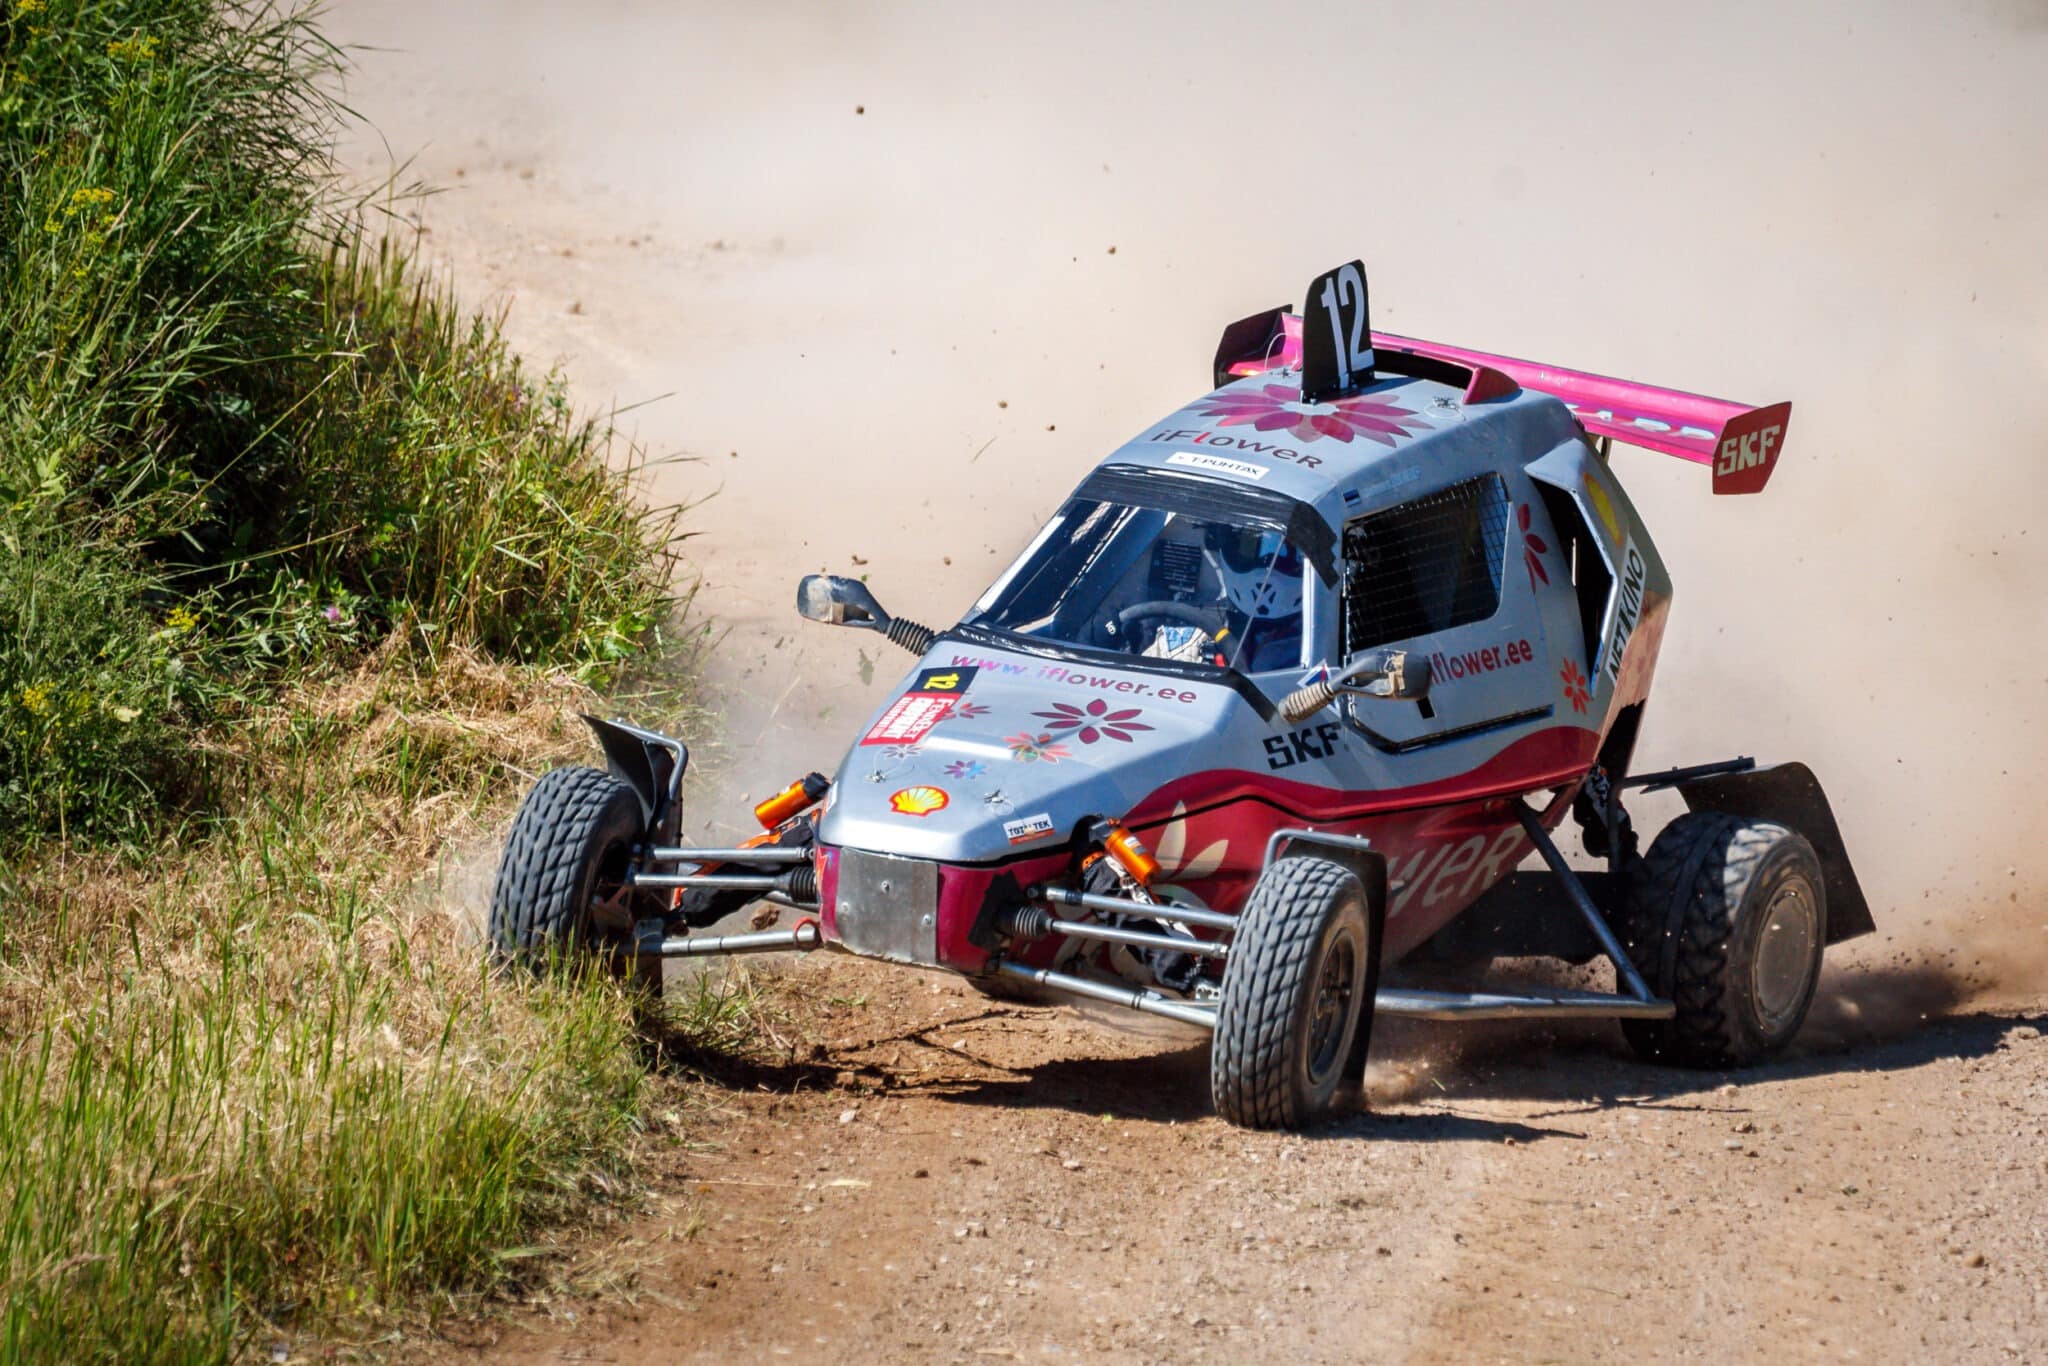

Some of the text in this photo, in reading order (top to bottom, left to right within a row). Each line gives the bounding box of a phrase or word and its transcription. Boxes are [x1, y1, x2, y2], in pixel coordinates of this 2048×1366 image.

[1321, 264, 1375, 389] 12
[1717, 425, 1781, 476] SKF
[923, 672, 960, 689] 12
[1262, 722, 1341, 770] SKF
